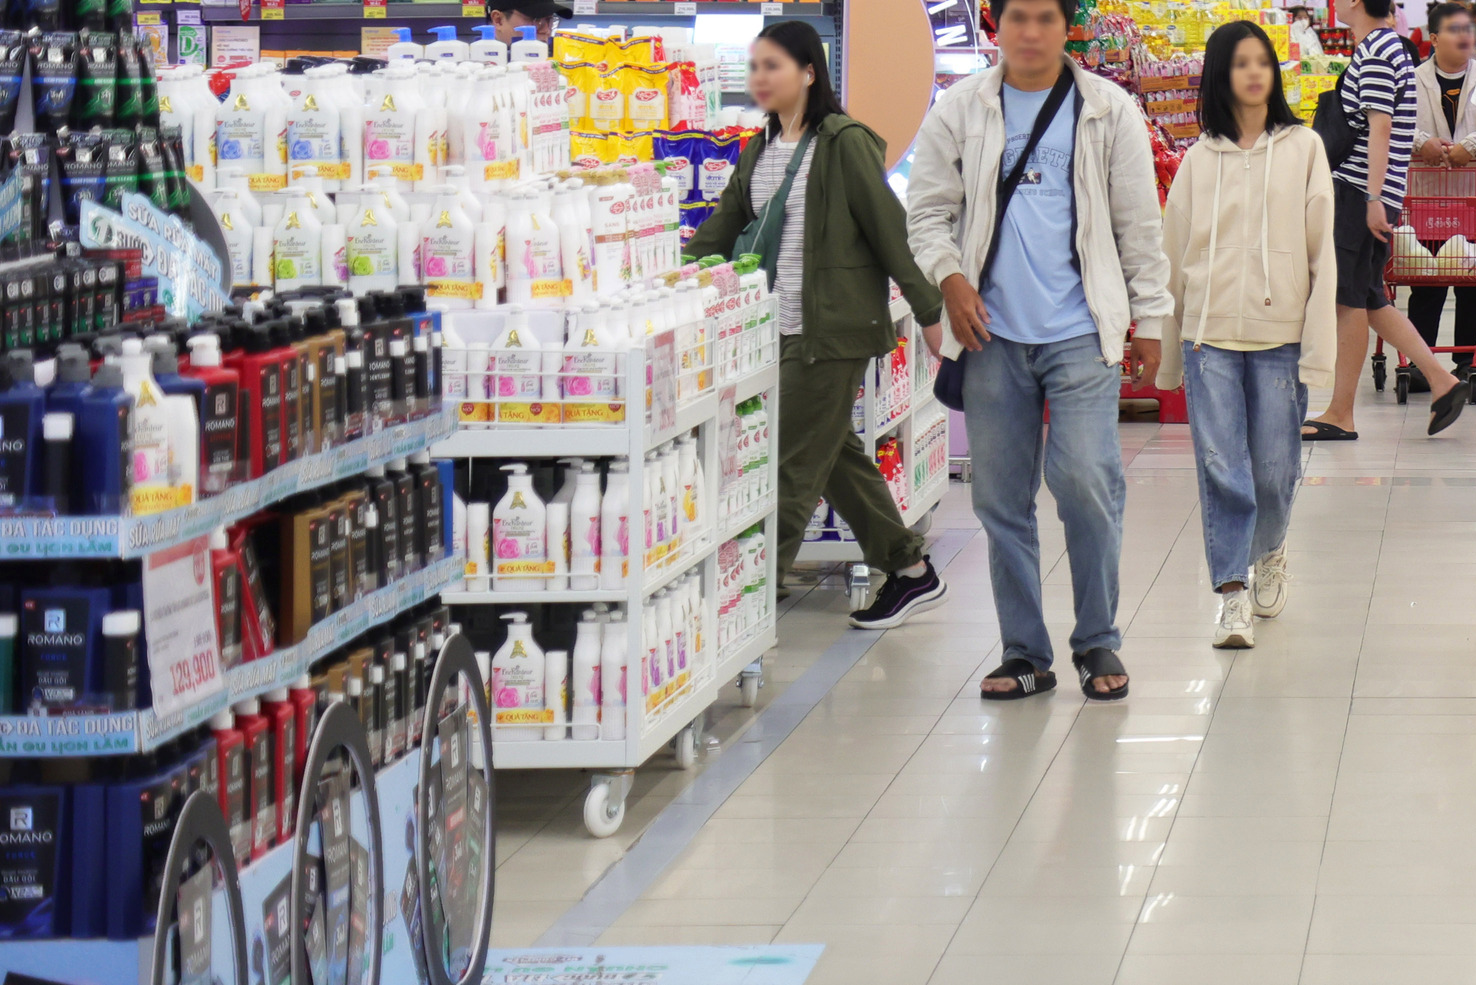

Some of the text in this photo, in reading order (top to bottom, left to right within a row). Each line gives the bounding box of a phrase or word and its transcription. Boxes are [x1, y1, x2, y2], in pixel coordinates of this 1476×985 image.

[205, 418, 235, 431] ROMANO
[28, 634, 83, 645] ROMANO
[0, 831, 52, 843] OMANO
